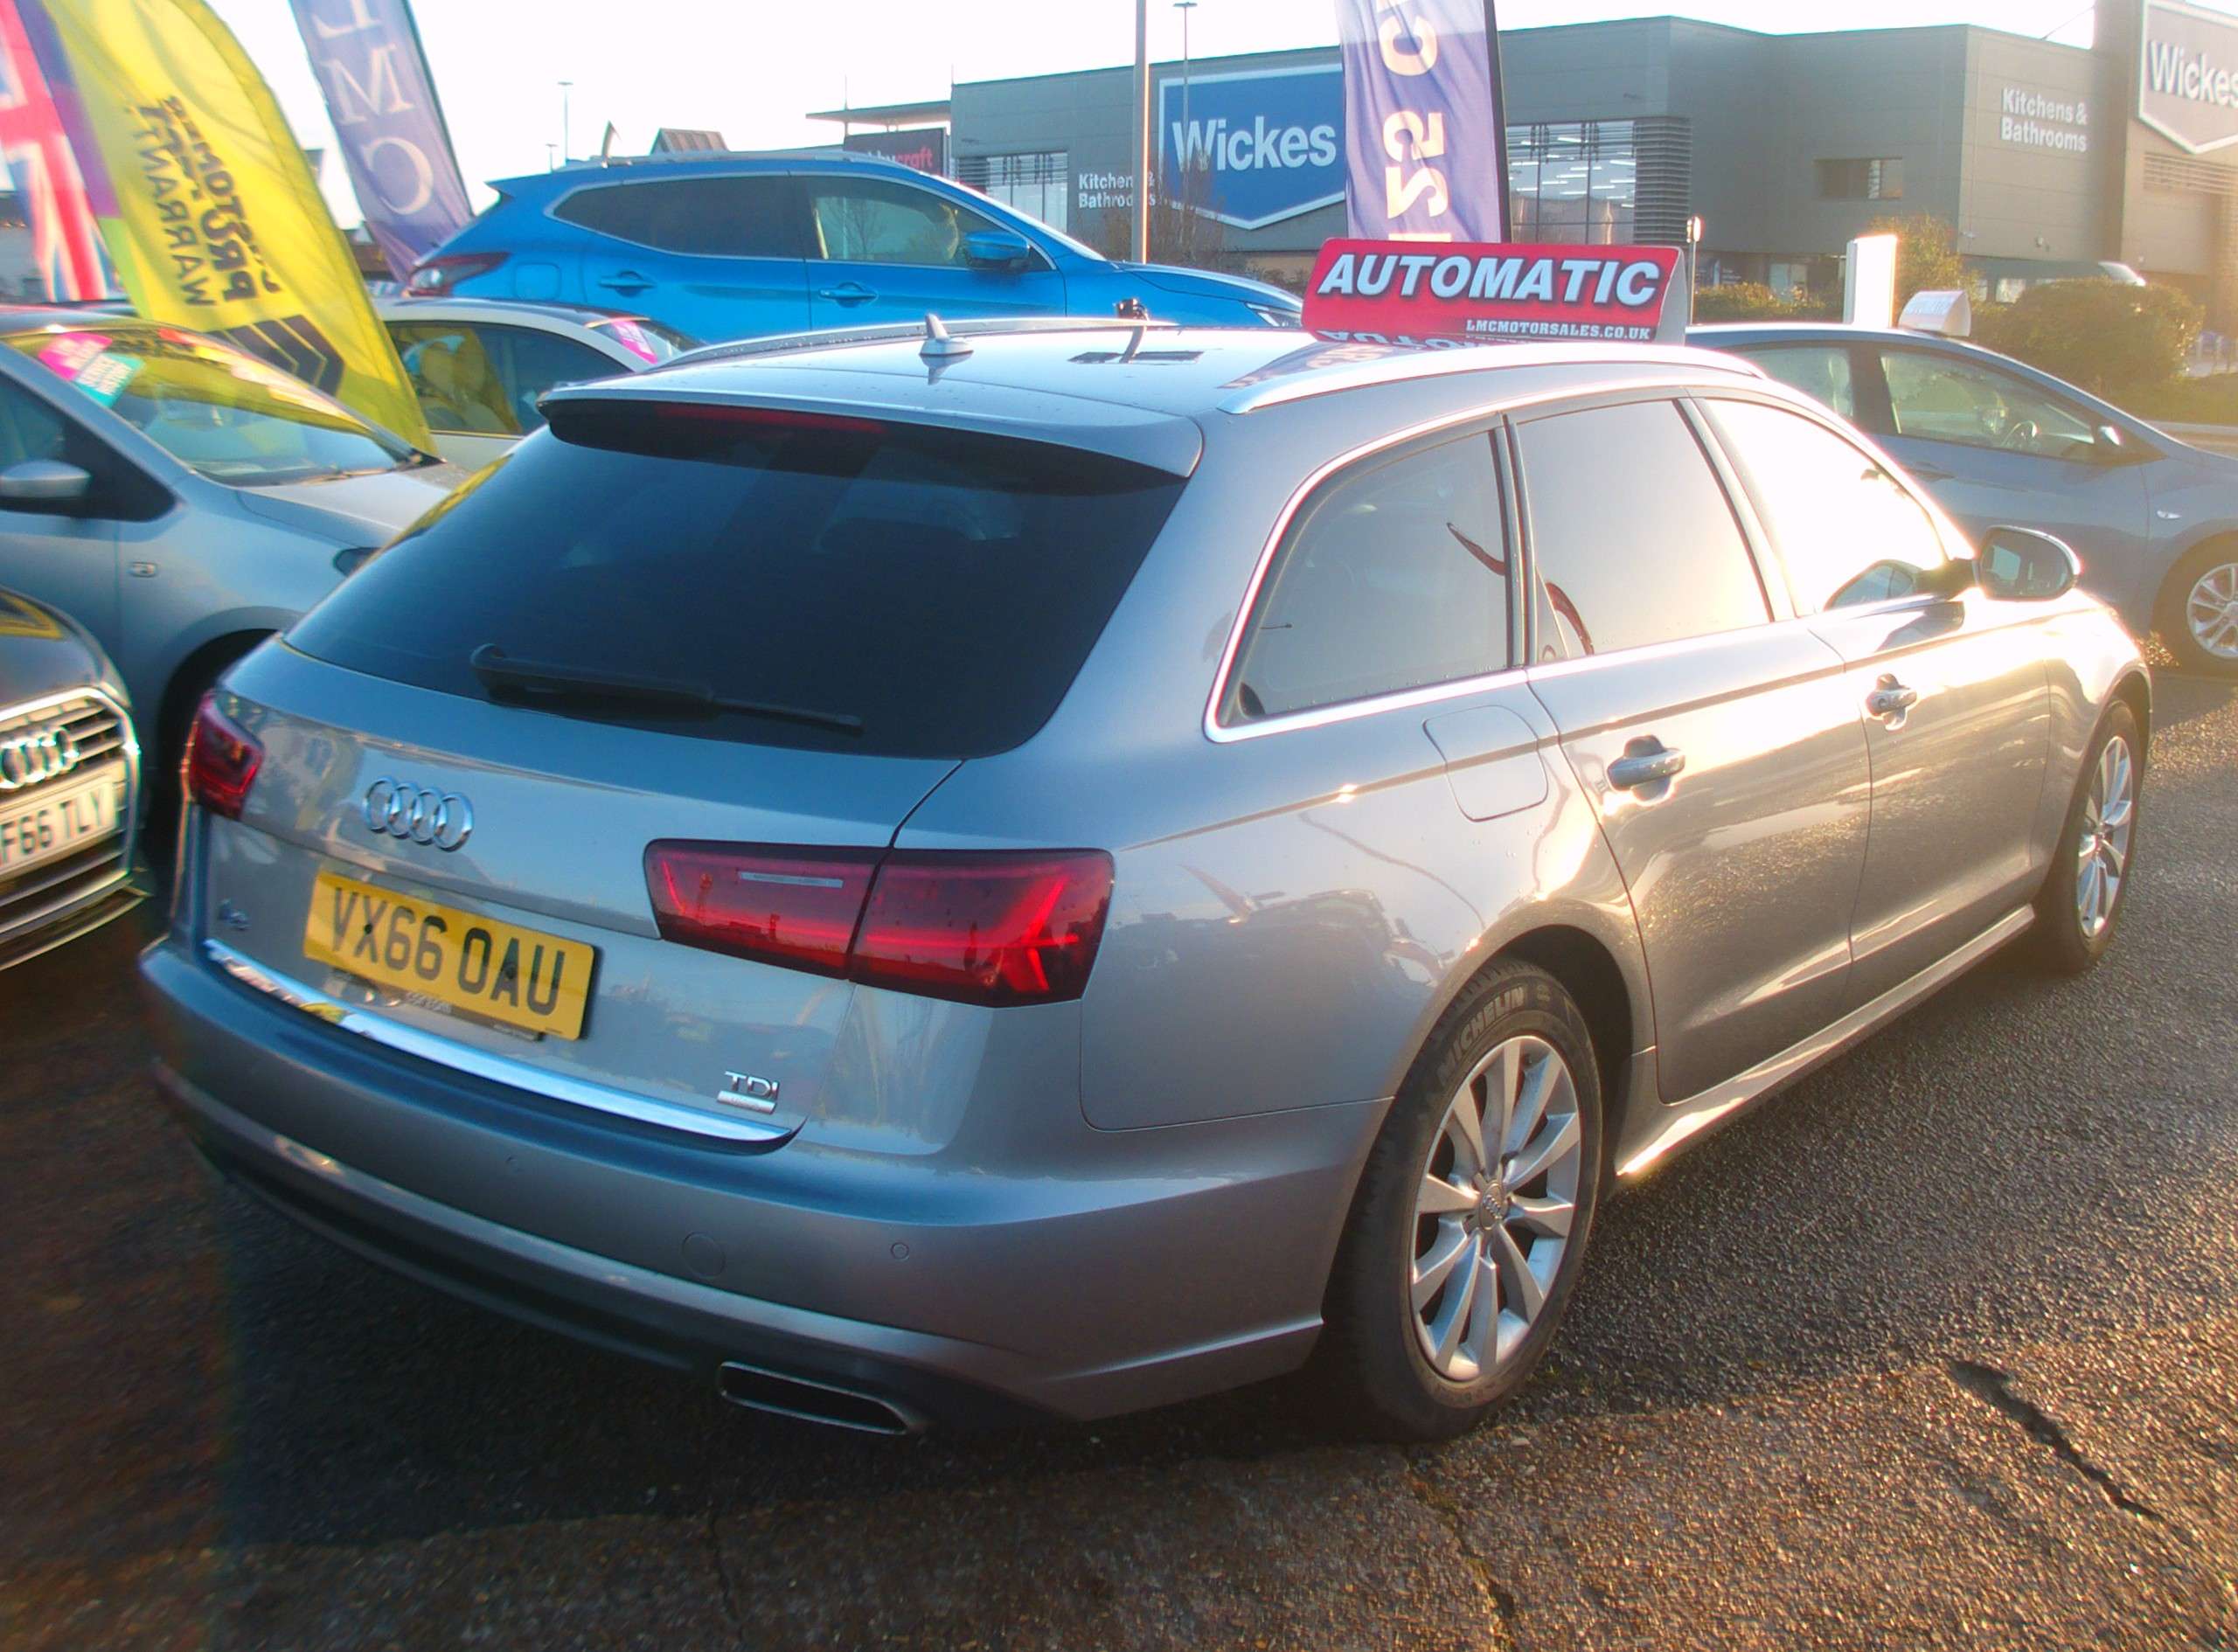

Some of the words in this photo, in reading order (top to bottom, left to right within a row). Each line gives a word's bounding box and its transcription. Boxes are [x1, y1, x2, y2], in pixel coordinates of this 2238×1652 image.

[2148, 41, 2238, 108] Wickes
[2002, 87, 2074, 123] Kitchens
[2075, 101, 2088, 125] &
[1171, 115, 1337, 172] Wickes
[2001, 115, 2088, 152] Bathrooms
[1078, 171, 1134, 191] Kitchen
[1078, 191, 1157, 209] Bathroos
[1317, 253, 1660, 307] AUTOMATIC
[1466, 319, 1652, 340] LMCMOTORSALES.CO.UK
[59, 789, 105, 840] TLY
[332, 886, 448, 981] VX66
[457, 927, 566, 1017] OAU
[1436, 985, 1526, 1088] MICHELIN
[725, 1071, 779, 1100] TDI
